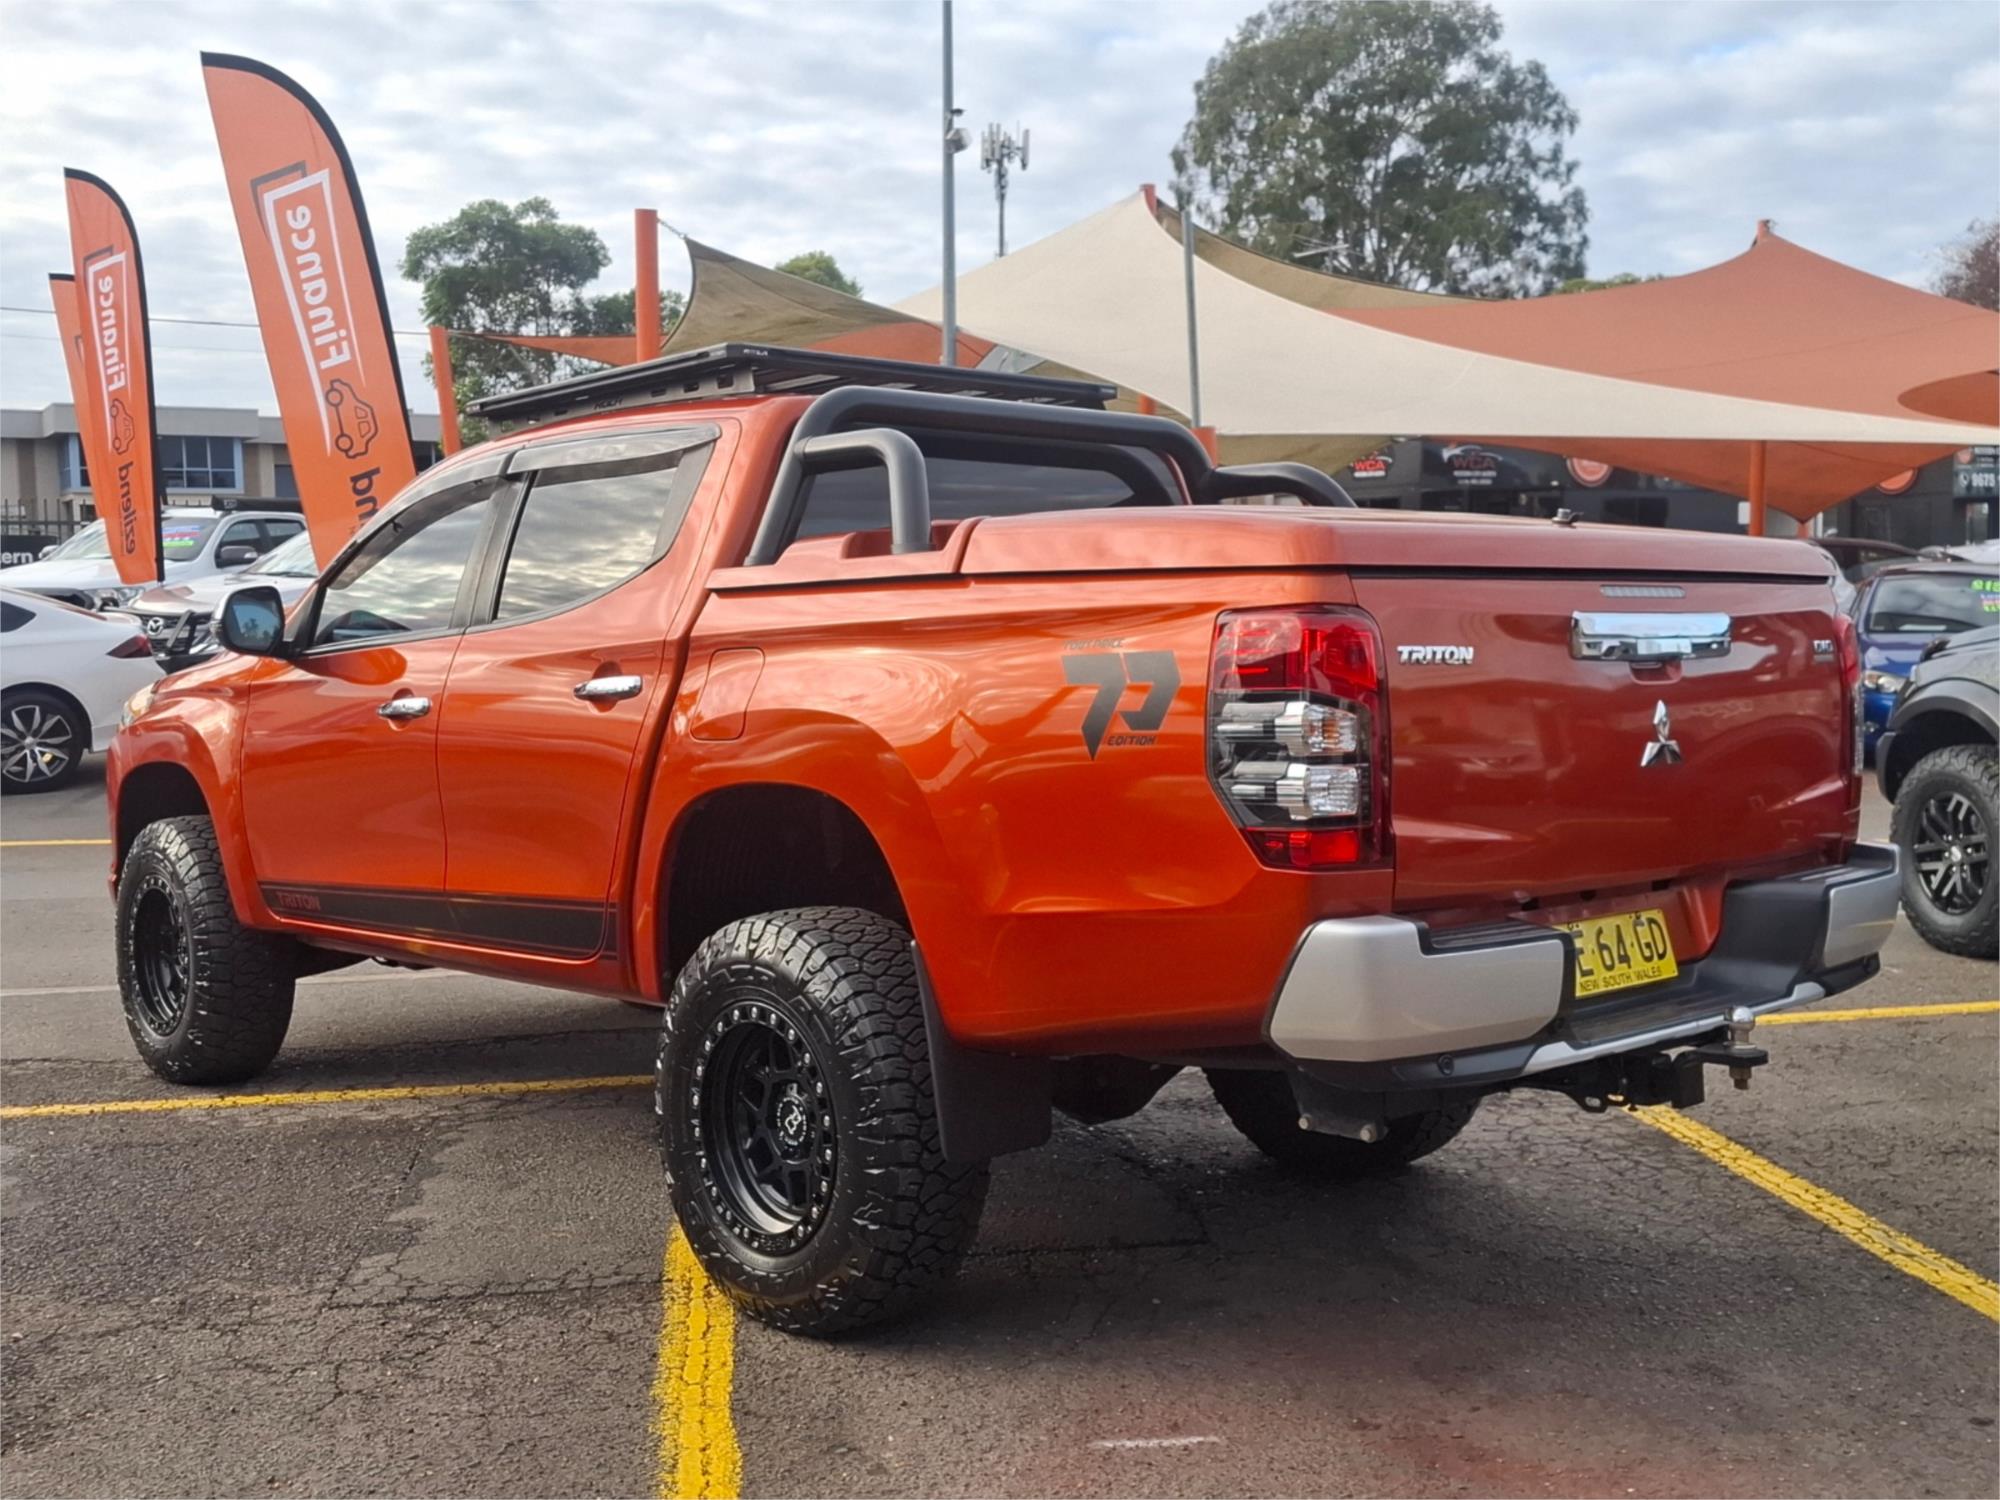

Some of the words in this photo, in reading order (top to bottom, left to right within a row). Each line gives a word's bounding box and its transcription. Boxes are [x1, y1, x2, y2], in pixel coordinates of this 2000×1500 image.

[1397, 646, 1475, 665] TRITON
[1106, 735, 1156, 746] EDITION
[276, 891, 321, 911] TRITON
[1579, 979, 1600, 992] NEW
[1603, 973, 1632, 989] SOUTH
[1635, 966, 1662, 981] WALES
